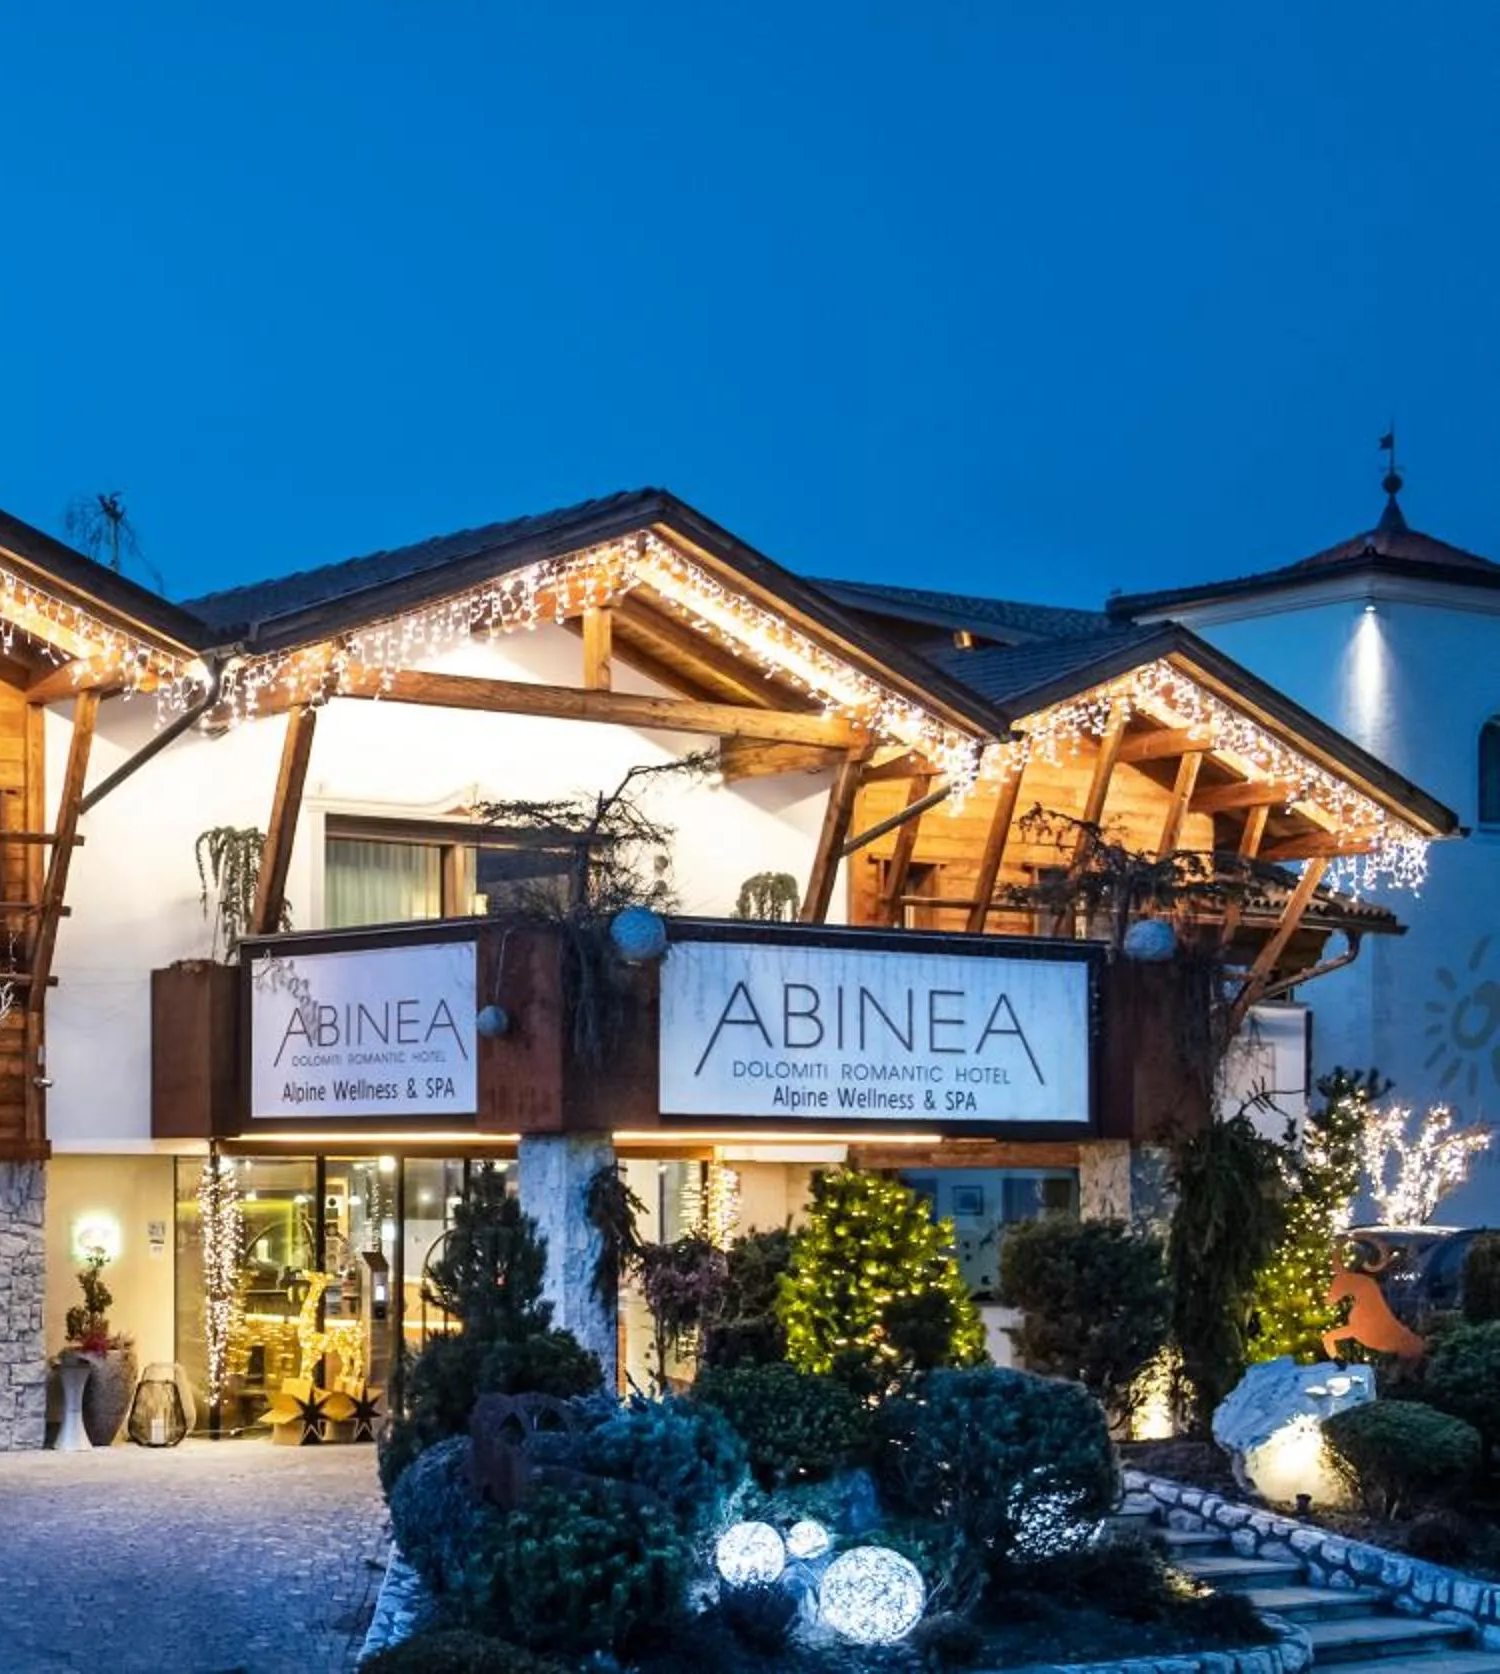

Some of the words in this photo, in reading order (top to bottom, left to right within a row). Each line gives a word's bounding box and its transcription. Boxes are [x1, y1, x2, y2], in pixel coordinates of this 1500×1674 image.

[272, 998, 470, 1068] ABINEA
[694, 980, 1045, 1085] ABINEA
[291, 1053, 343, 1067] DOLOMITI
[347, 1050, 406, 1065] ROMANTIC
[411, 1049, 447, 1063] HOTEL
[732, 1060, 829, 1079] DOLOMITI
[841, 1063, 943, 1083] ROMANTIC
[955, 1066, 1011, 1085] HOTEL
[282, 1081, 326, 1105] Alpine
[333, 1078, 399, 1101] Wellness
[406, 1077, 418, 1099] &
[425, 1076, 456, 1099] SPA
[772, 1085, 829, 1112] Alpine
[837, 1087, 915, 1110] Wellness
[923, 1089, 937, 1110] &
[945, 1091, 977, 1111] SPA
